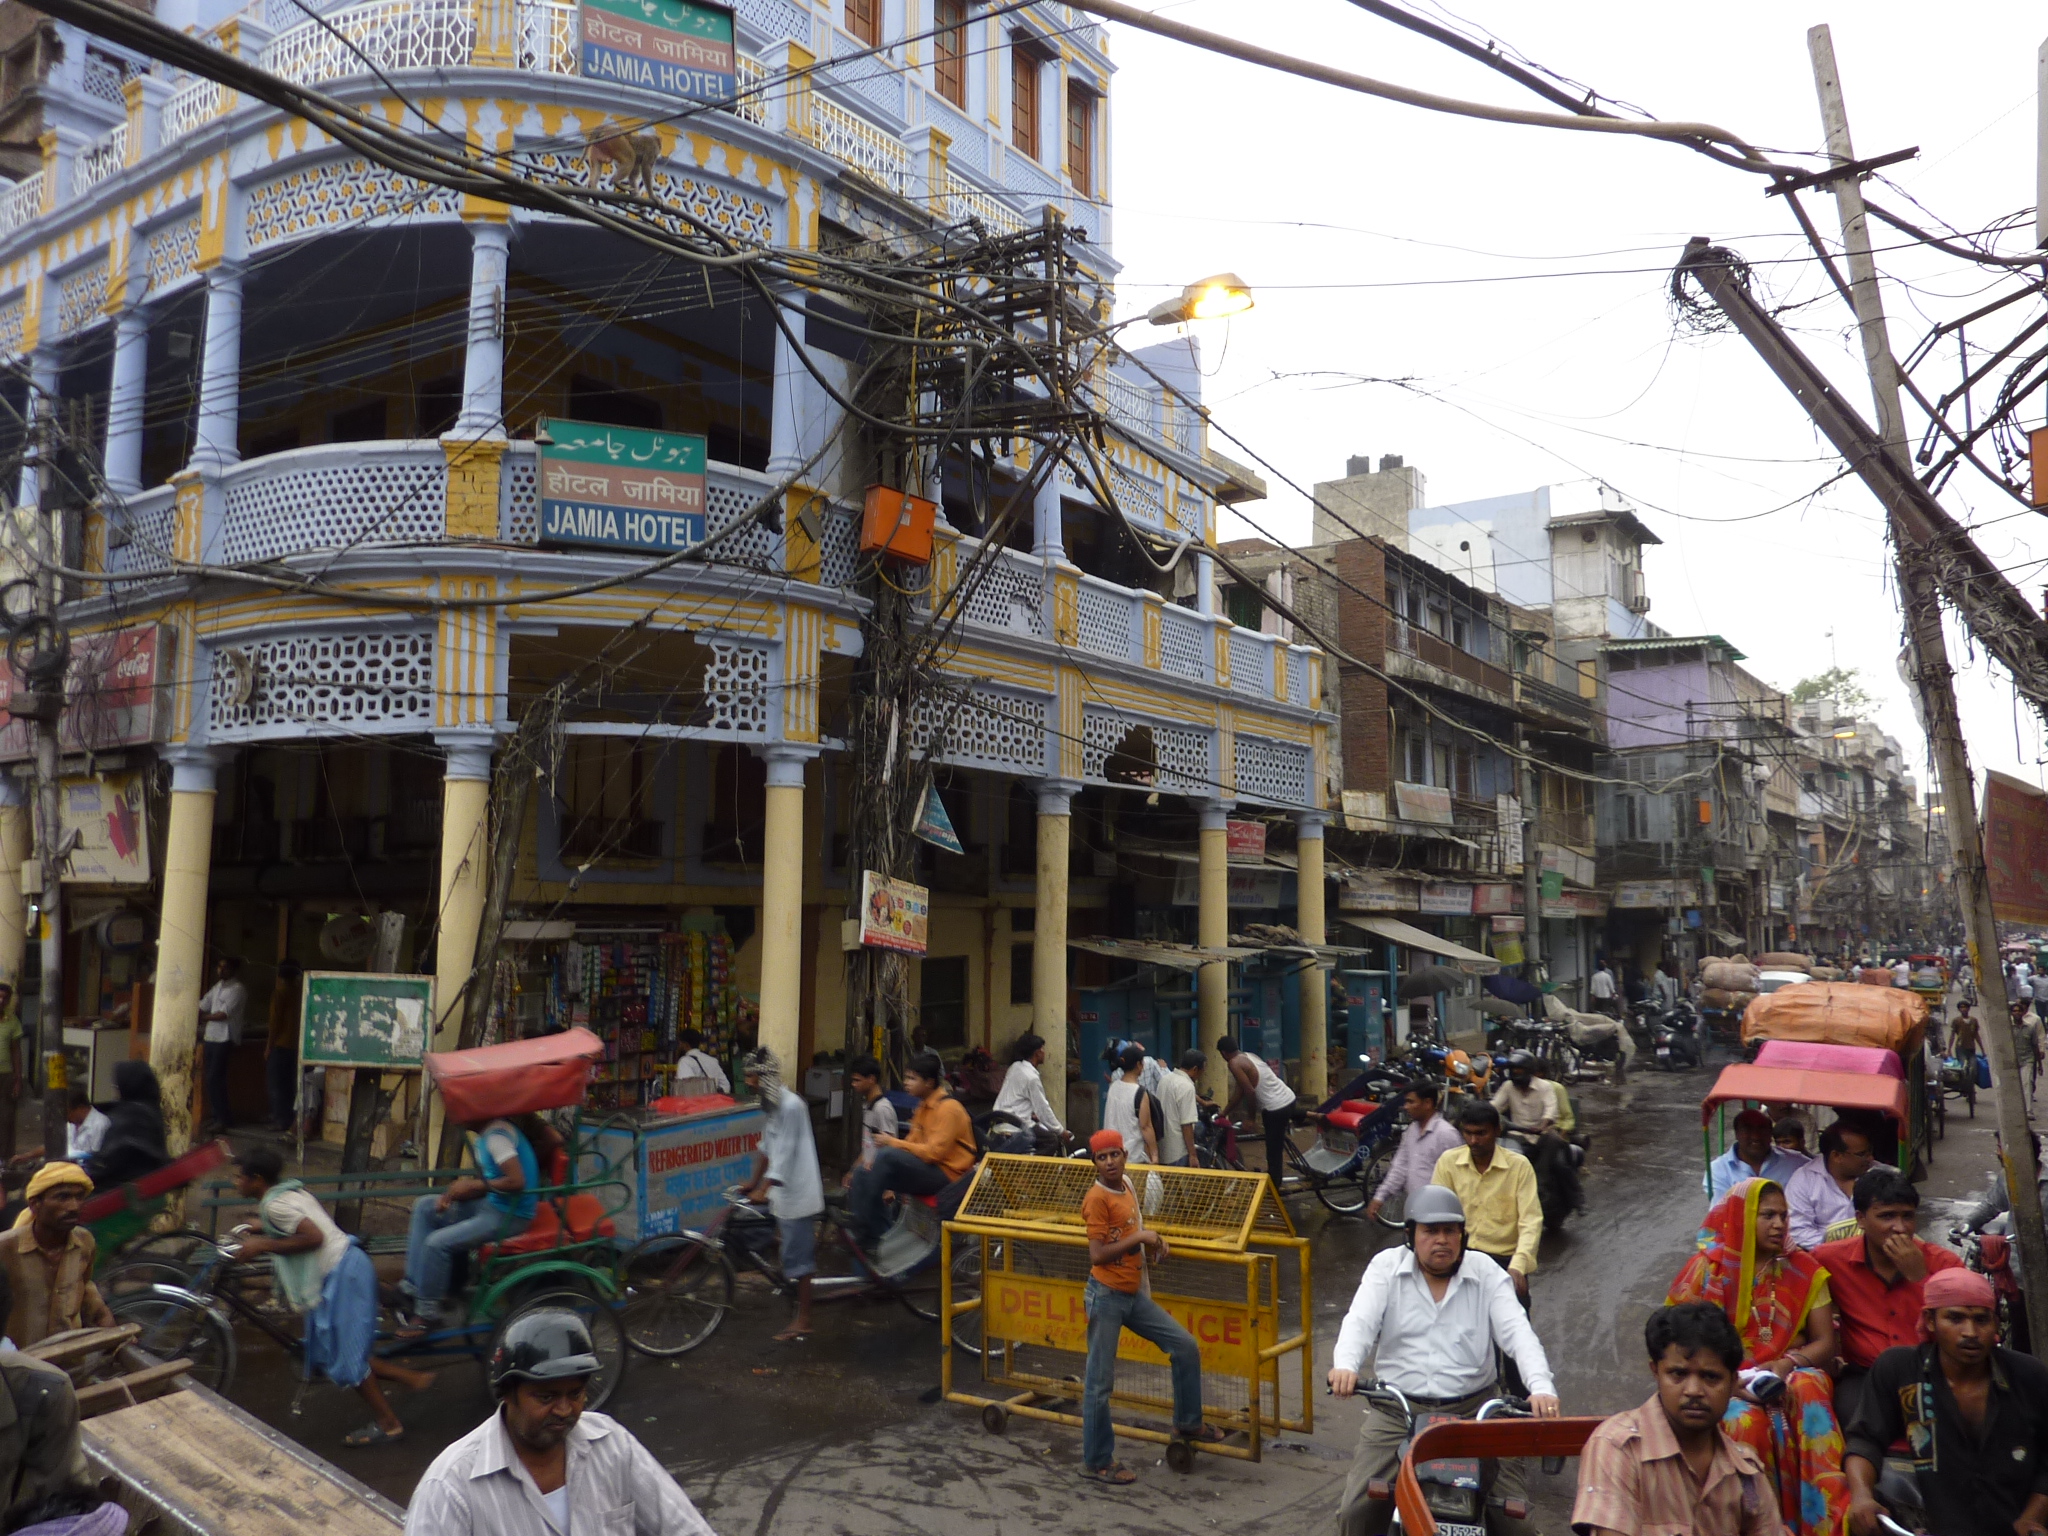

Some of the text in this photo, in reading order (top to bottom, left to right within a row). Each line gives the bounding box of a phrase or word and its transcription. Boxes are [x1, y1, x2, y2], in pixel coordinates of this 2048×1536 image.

[585, 14, 728, 68] होटल जामिया
[588, 48, 730, 100] JAMIA HOTEL
[546, 465, 701, 506] होटल जामिया
[547, 505, 702, 547] JAMIA HOTEL
[649, 1141, 714, 1173] REFRIGERATED
[715, 1134, 742, 1159] WATER
[1001, 1287, 1089, 1324] DELH
